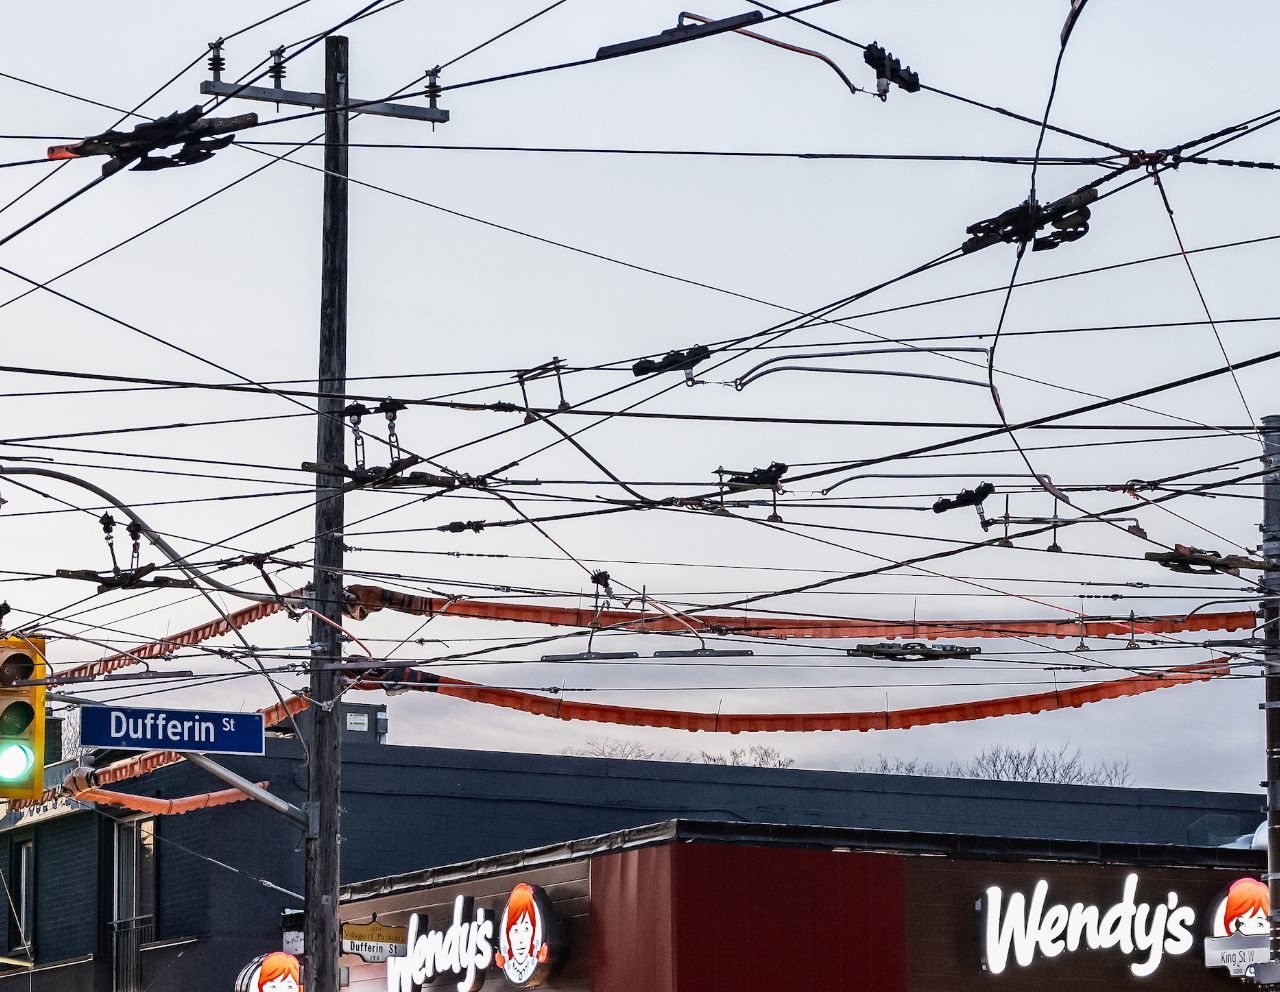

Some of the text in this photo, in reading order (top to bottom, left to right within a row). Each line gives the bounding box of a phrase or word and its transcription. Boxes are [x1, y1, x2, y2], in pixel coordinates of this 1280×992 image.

[110, 711, 235, 742] Dufferin St
[986, 873, 1195, 977] Wendy's
[350, 941, 398, 954] Dufferin St
[1220, 950, 1255, 966] King St W
